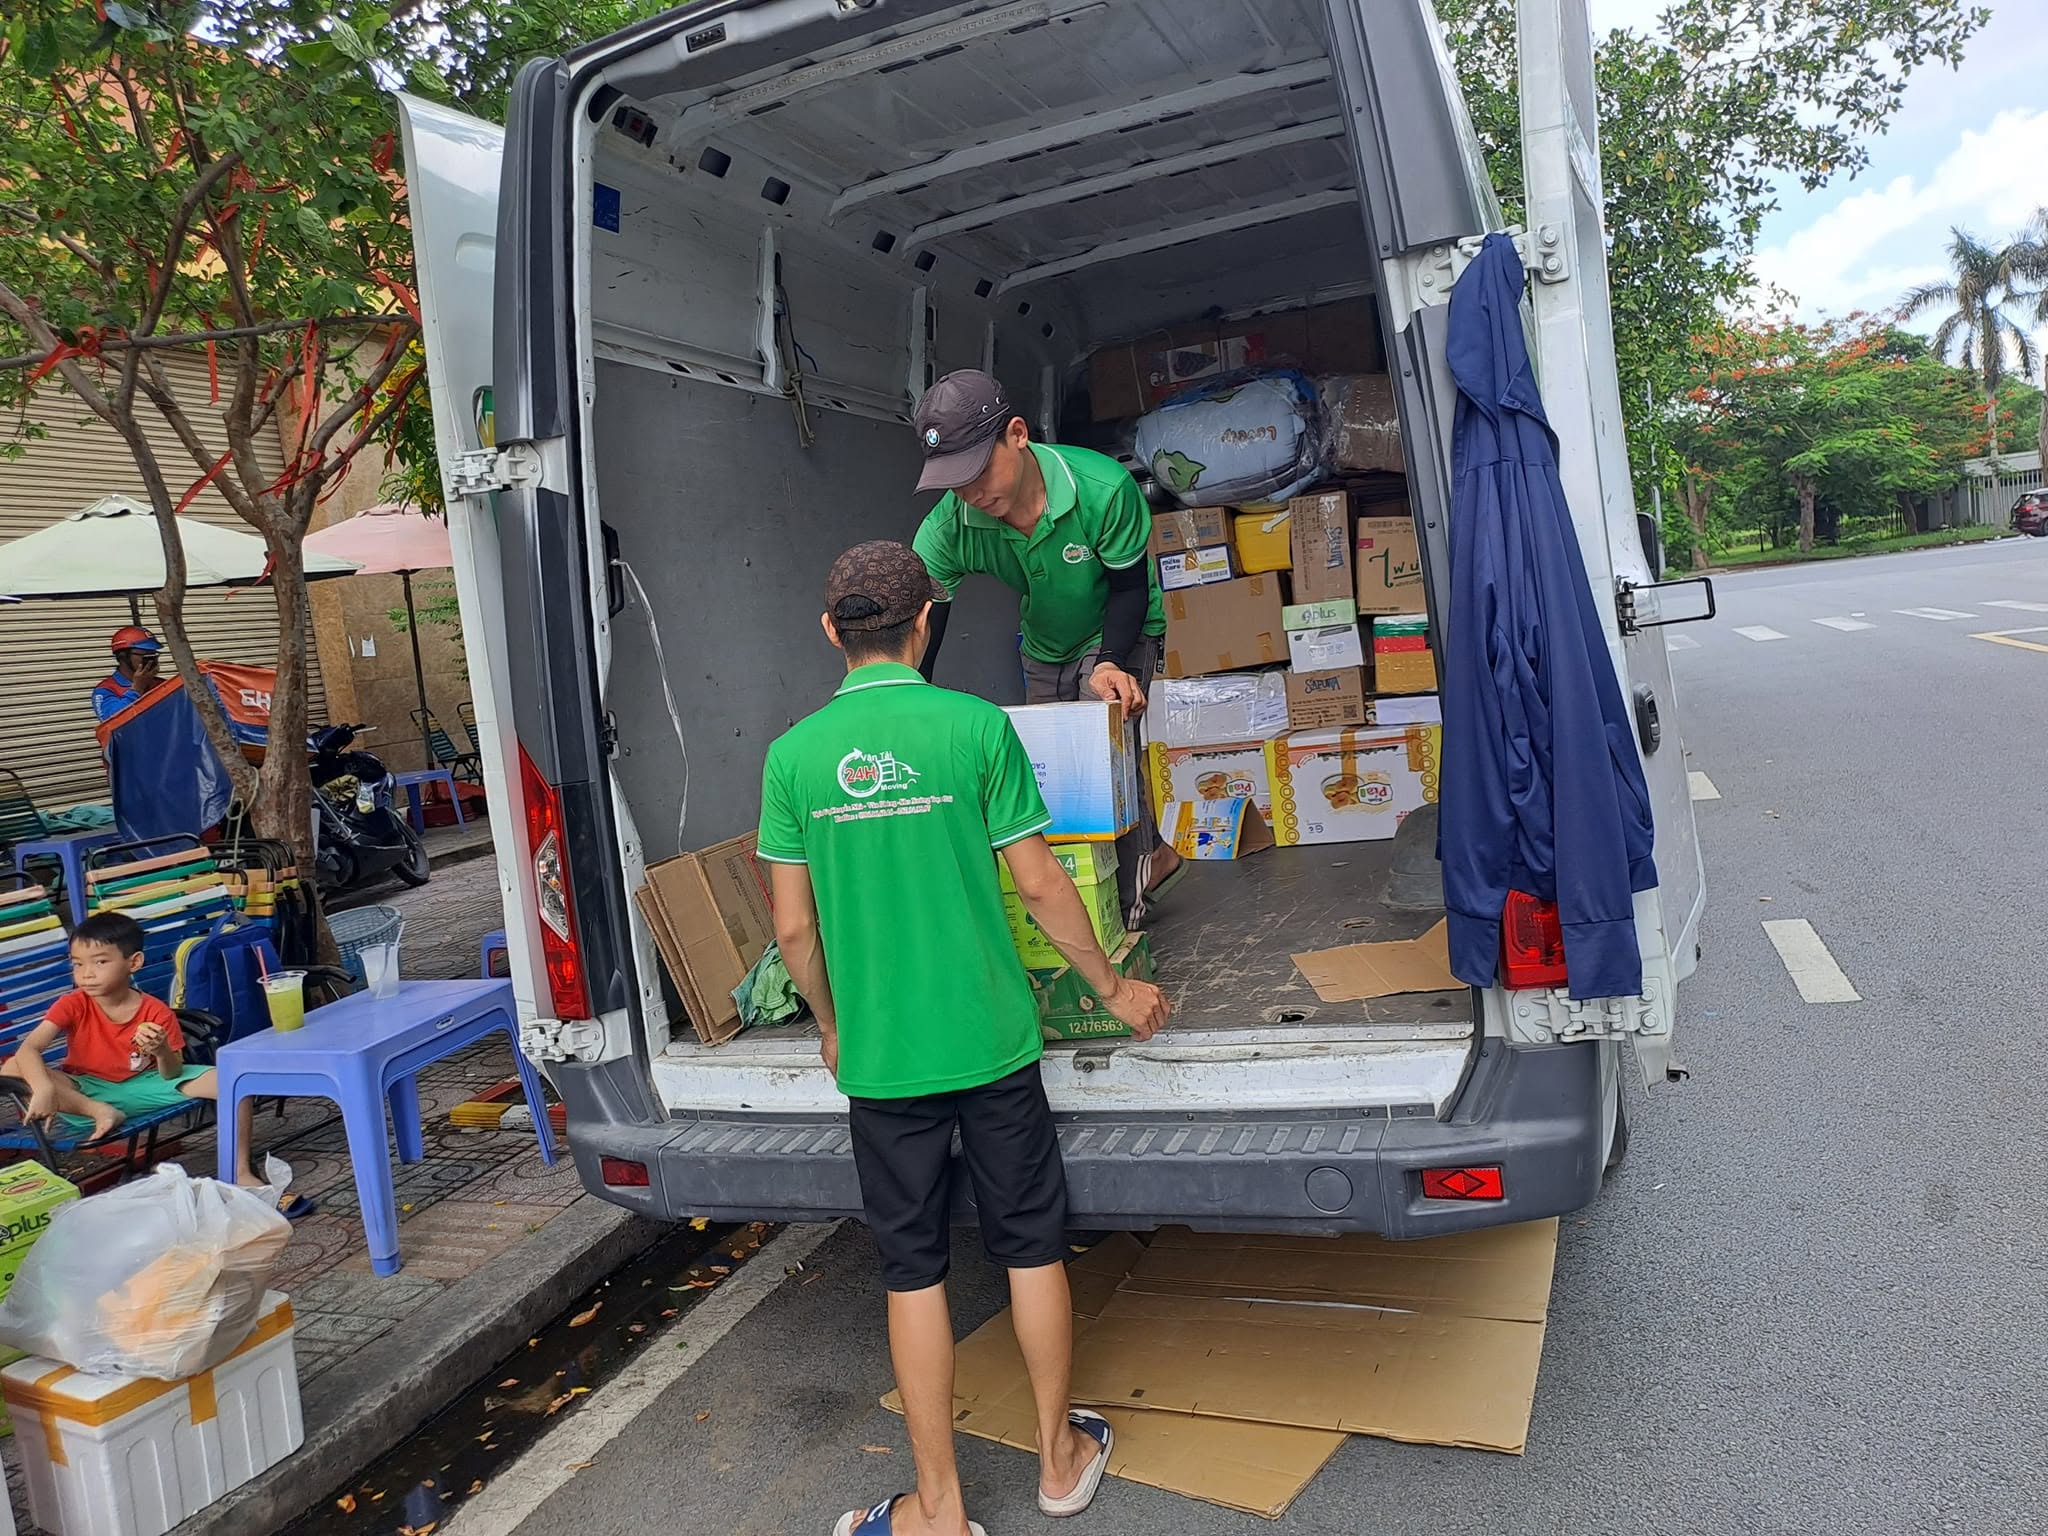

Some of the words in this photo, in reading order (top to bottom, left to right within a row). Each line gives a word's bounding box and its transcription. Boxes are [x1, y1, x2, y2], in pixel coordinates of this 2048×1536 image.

[845, 765, 878, 783] 24H
[881, 783, 908, 791] Moving
[1068, 1019, 1124, 1034] 12476563
